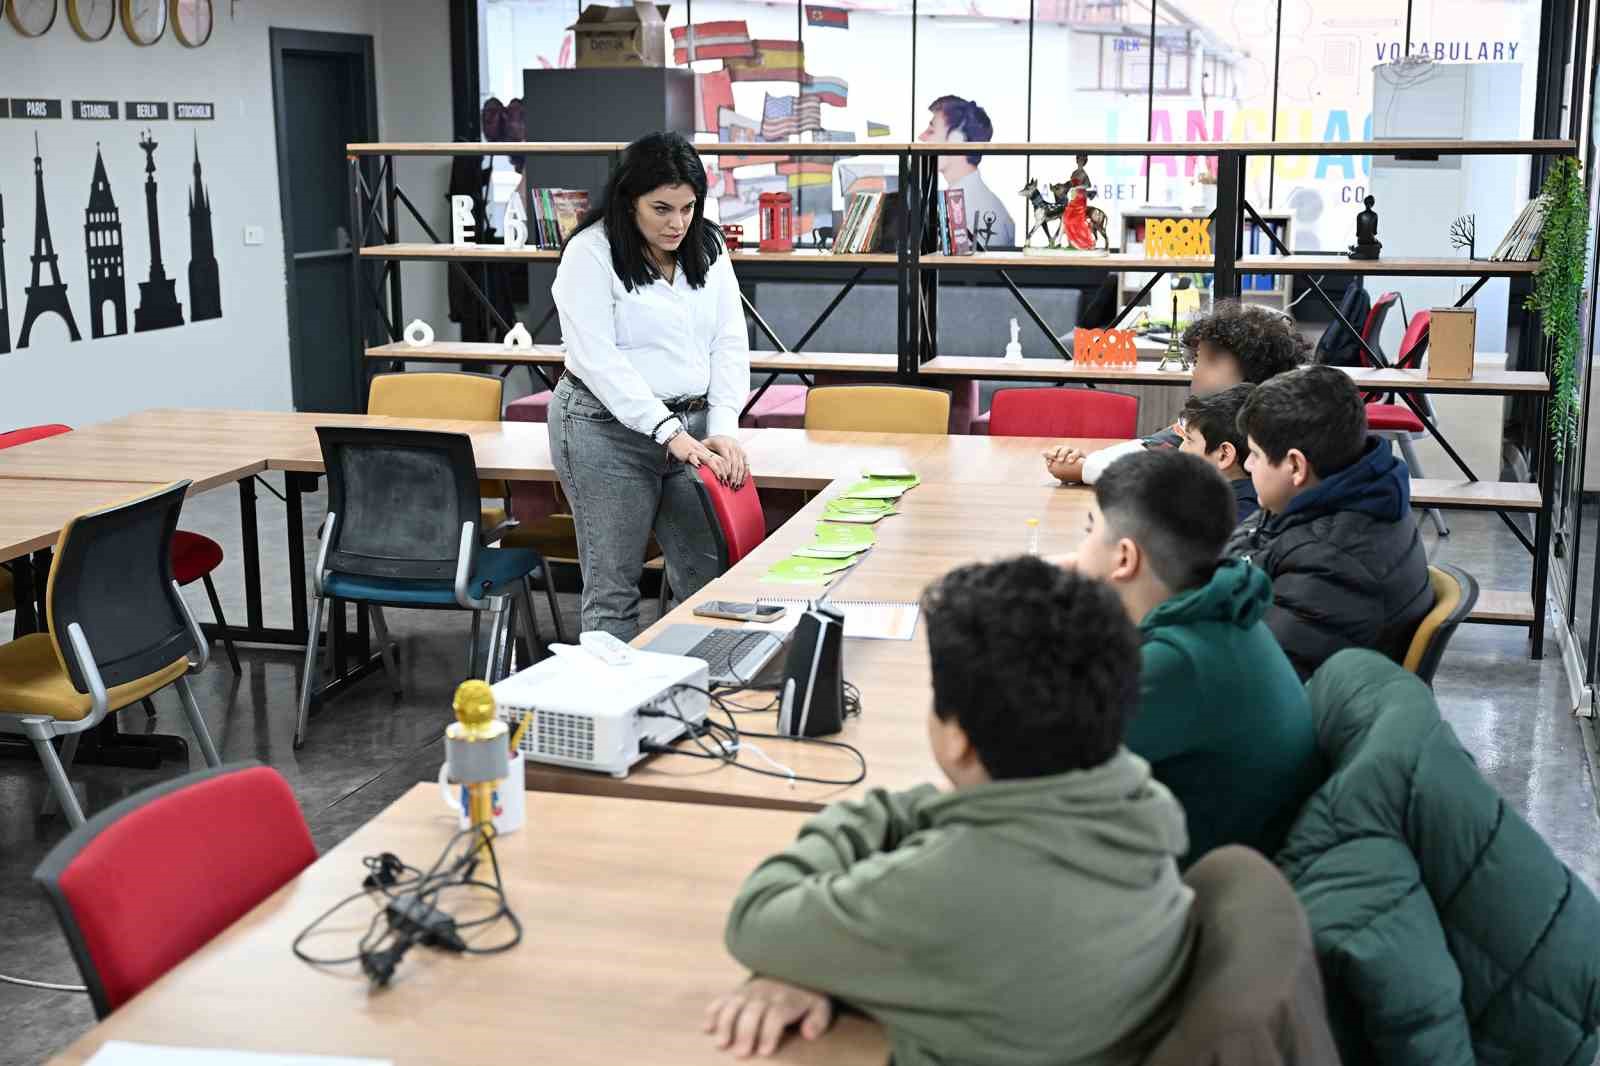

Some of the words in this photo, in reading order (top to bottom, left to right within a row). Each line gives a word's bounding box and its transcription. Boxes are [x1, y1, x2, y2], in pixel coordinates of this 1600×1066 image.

[26, 101, 47, 117] PARIS
[1104, 110, 1373, 179] LANGUA
[1145, 218, 1211, 240] BOOK
